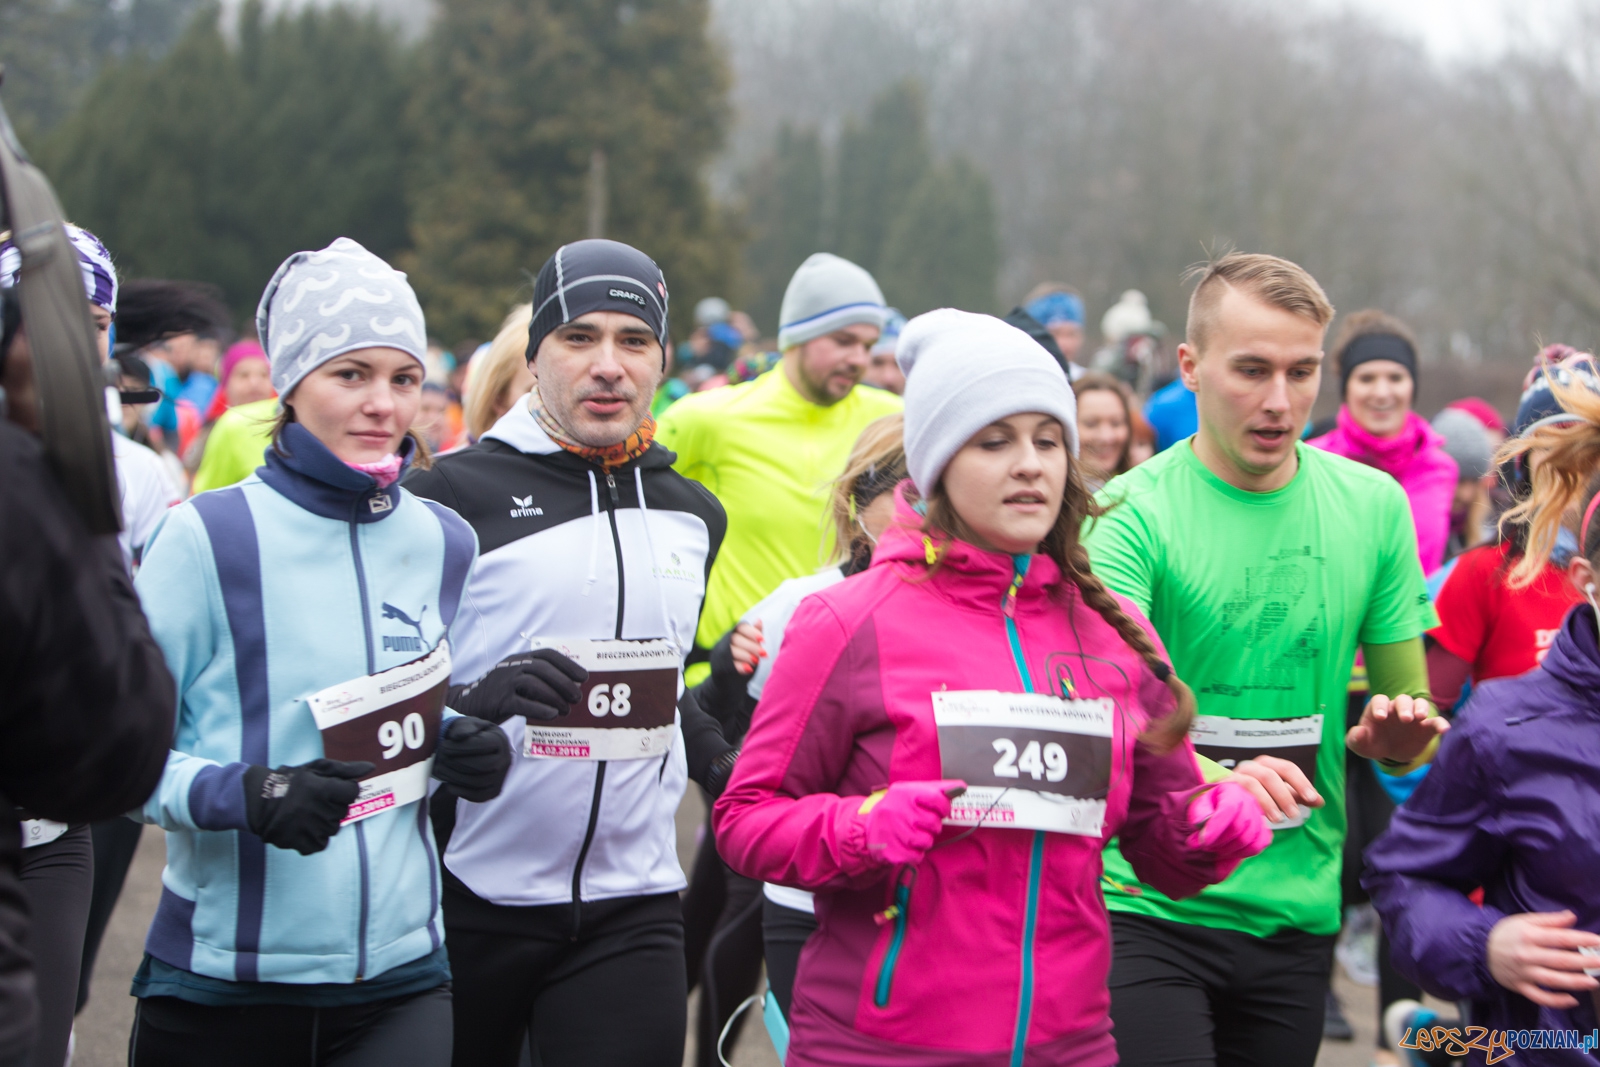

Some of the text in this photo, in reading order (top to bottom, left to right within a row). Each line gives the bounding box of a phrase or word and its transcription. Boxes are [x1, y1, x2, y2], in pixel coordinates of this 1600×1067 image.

[609, 288, 640, 302] CRAFT
[510, 506, 544, 518] erima
[382, 636, 422, 652] PUMA
[587, 682, 632, 718] 68
[377, 712, 426, 760] 90
[992, 737, 1068, 782] 249
